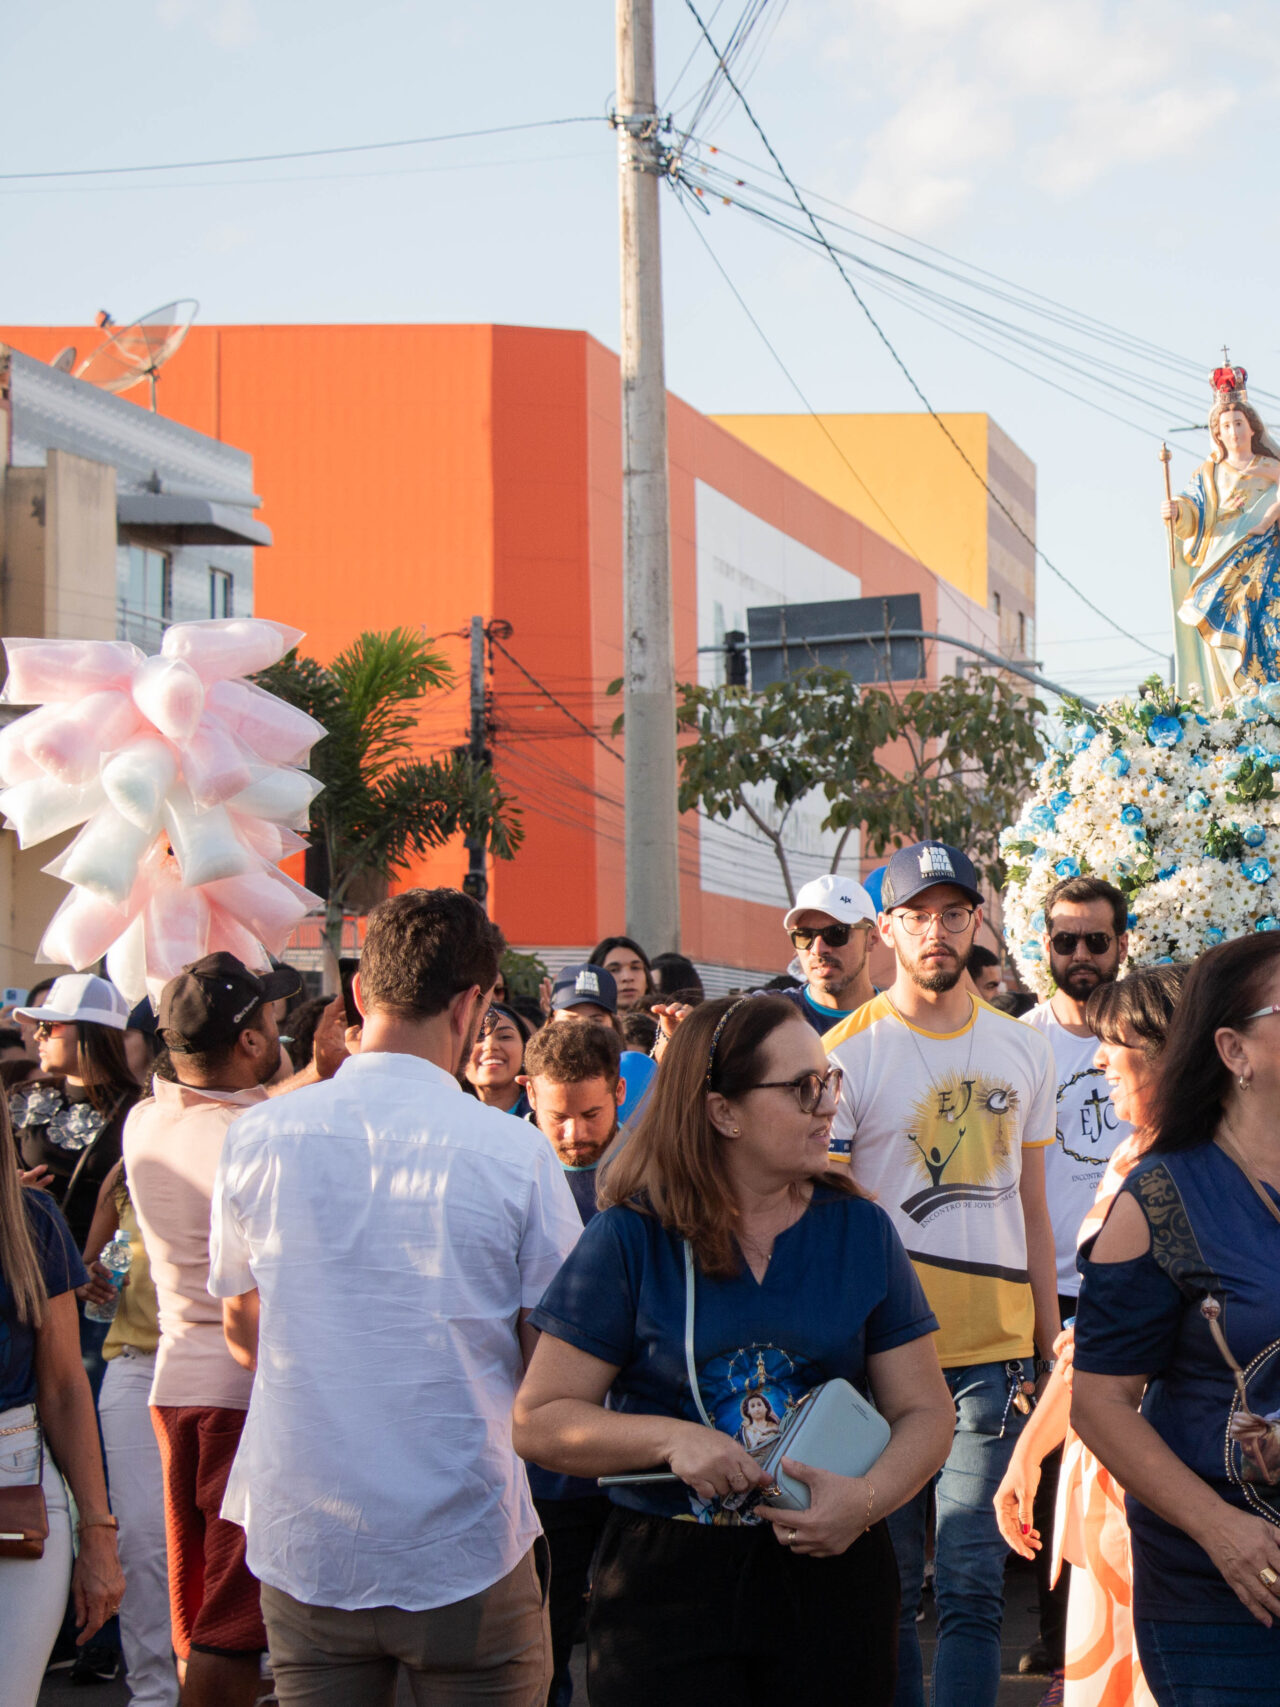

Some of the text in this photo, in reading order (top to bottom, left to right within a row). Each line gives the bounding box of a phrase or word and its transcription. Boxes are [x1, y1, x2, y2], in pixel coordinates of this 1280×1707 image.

[929, 847, 947, 855] RO
[931, 855, 950, 863] MA
[932, 863, 953, 872] RIA
[920, 1201, 961, 1229] ENCONTRO
[963, 1201, 974, 1209] DE
